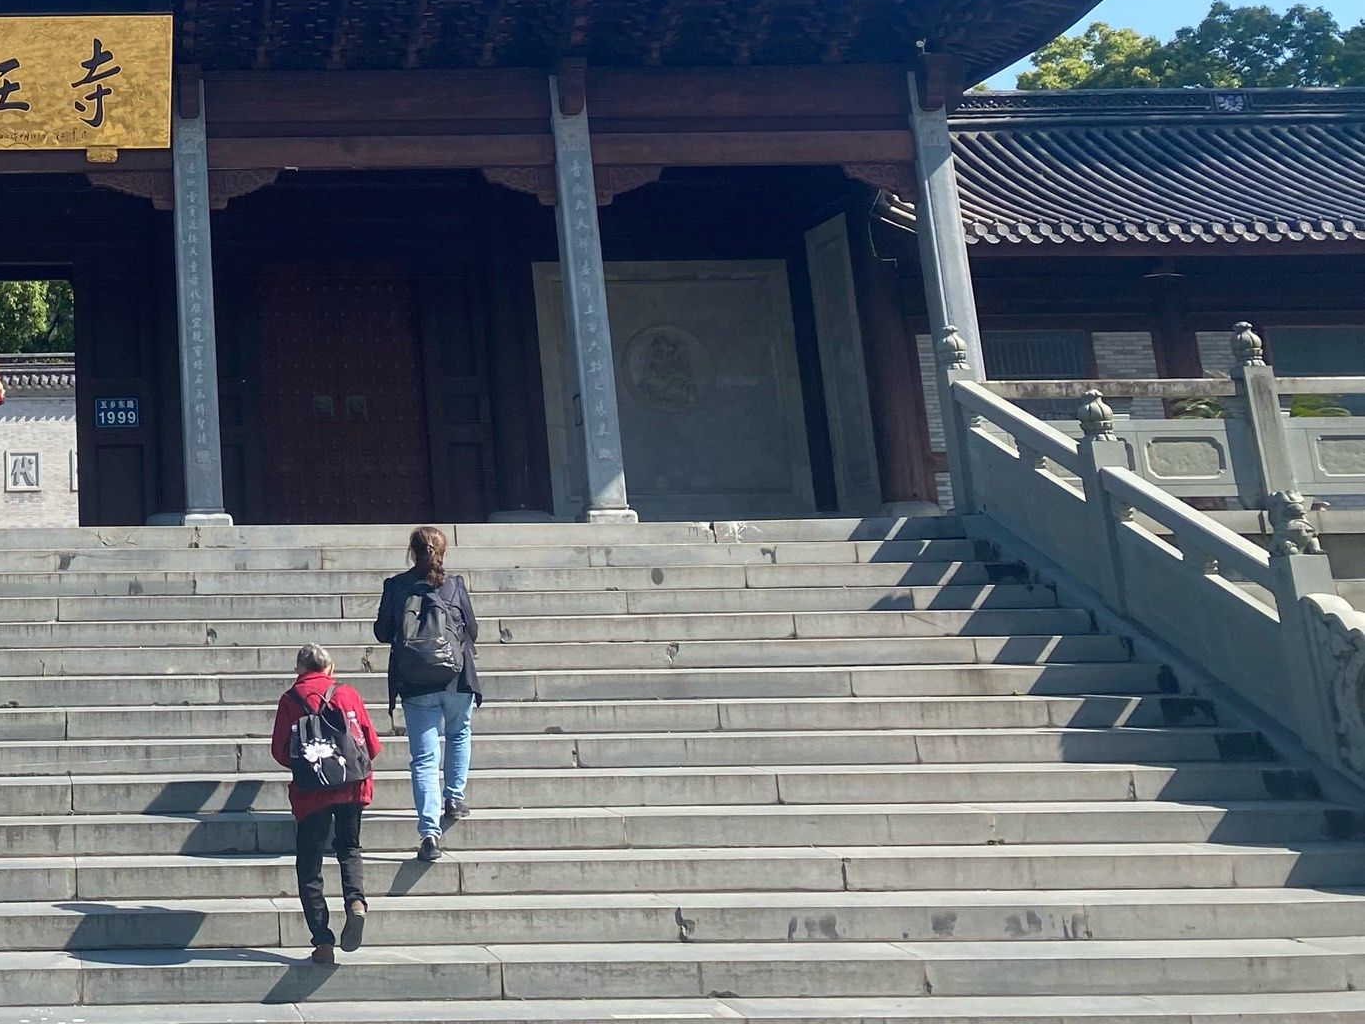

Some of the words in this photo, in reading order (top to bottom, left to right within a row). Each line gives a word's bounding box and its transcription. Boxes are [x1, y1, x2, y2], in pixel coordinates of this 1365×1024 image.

[100, 400, 135, 409] 五乡东路
[98, 411, 136, 424] 1999
[11, 456, 37, 487] 代
